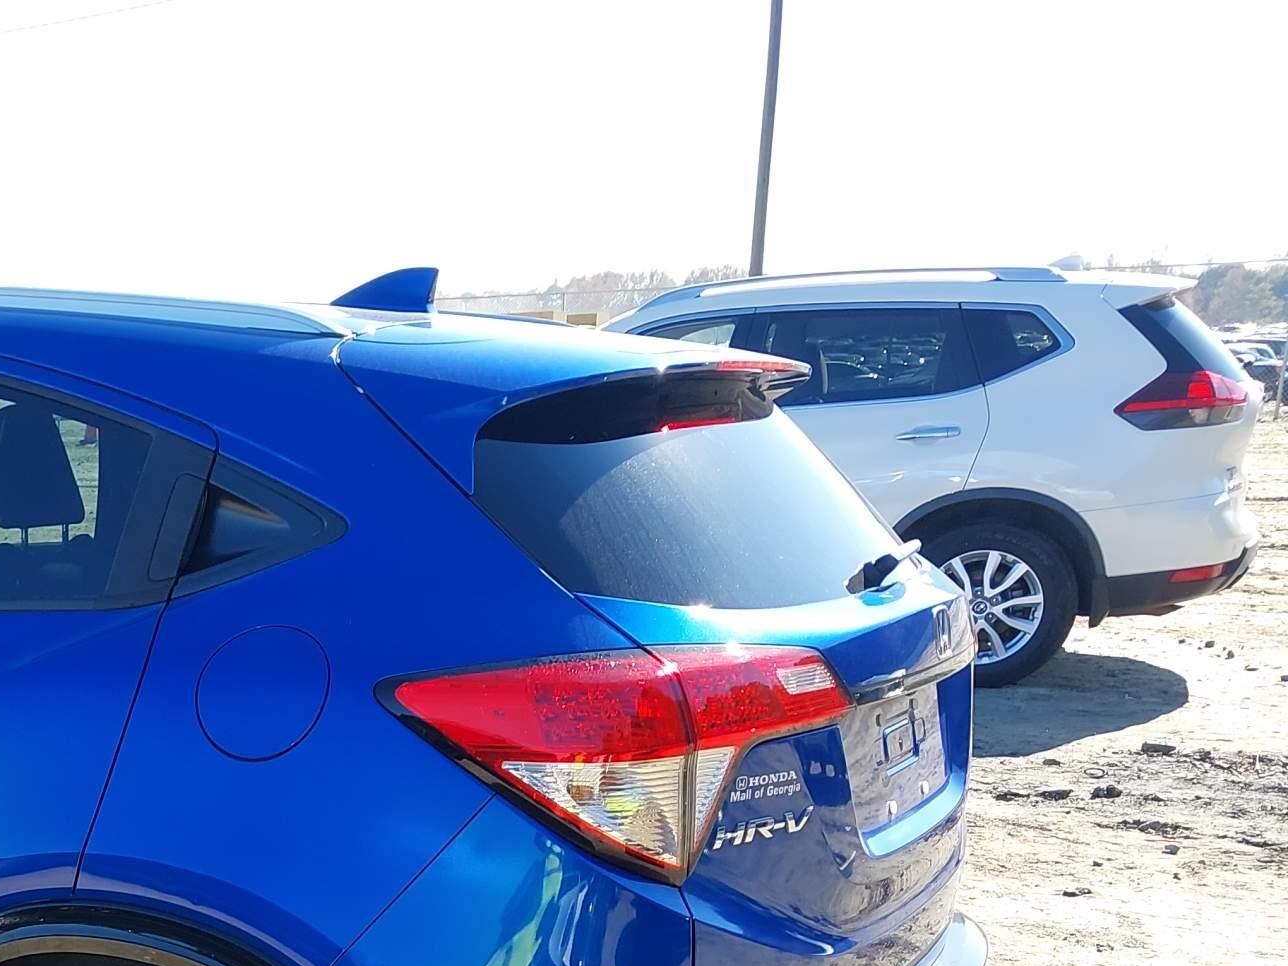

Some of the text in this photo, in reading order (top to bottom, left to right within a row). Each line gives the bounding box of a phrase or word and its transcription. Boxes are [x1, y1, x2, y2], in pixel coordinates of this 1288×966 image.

[748, 770, 797, 787] HONDA
[730, 782, 801, 802] Mall of Georgia
[712, 806, 814, 849] HR-V
